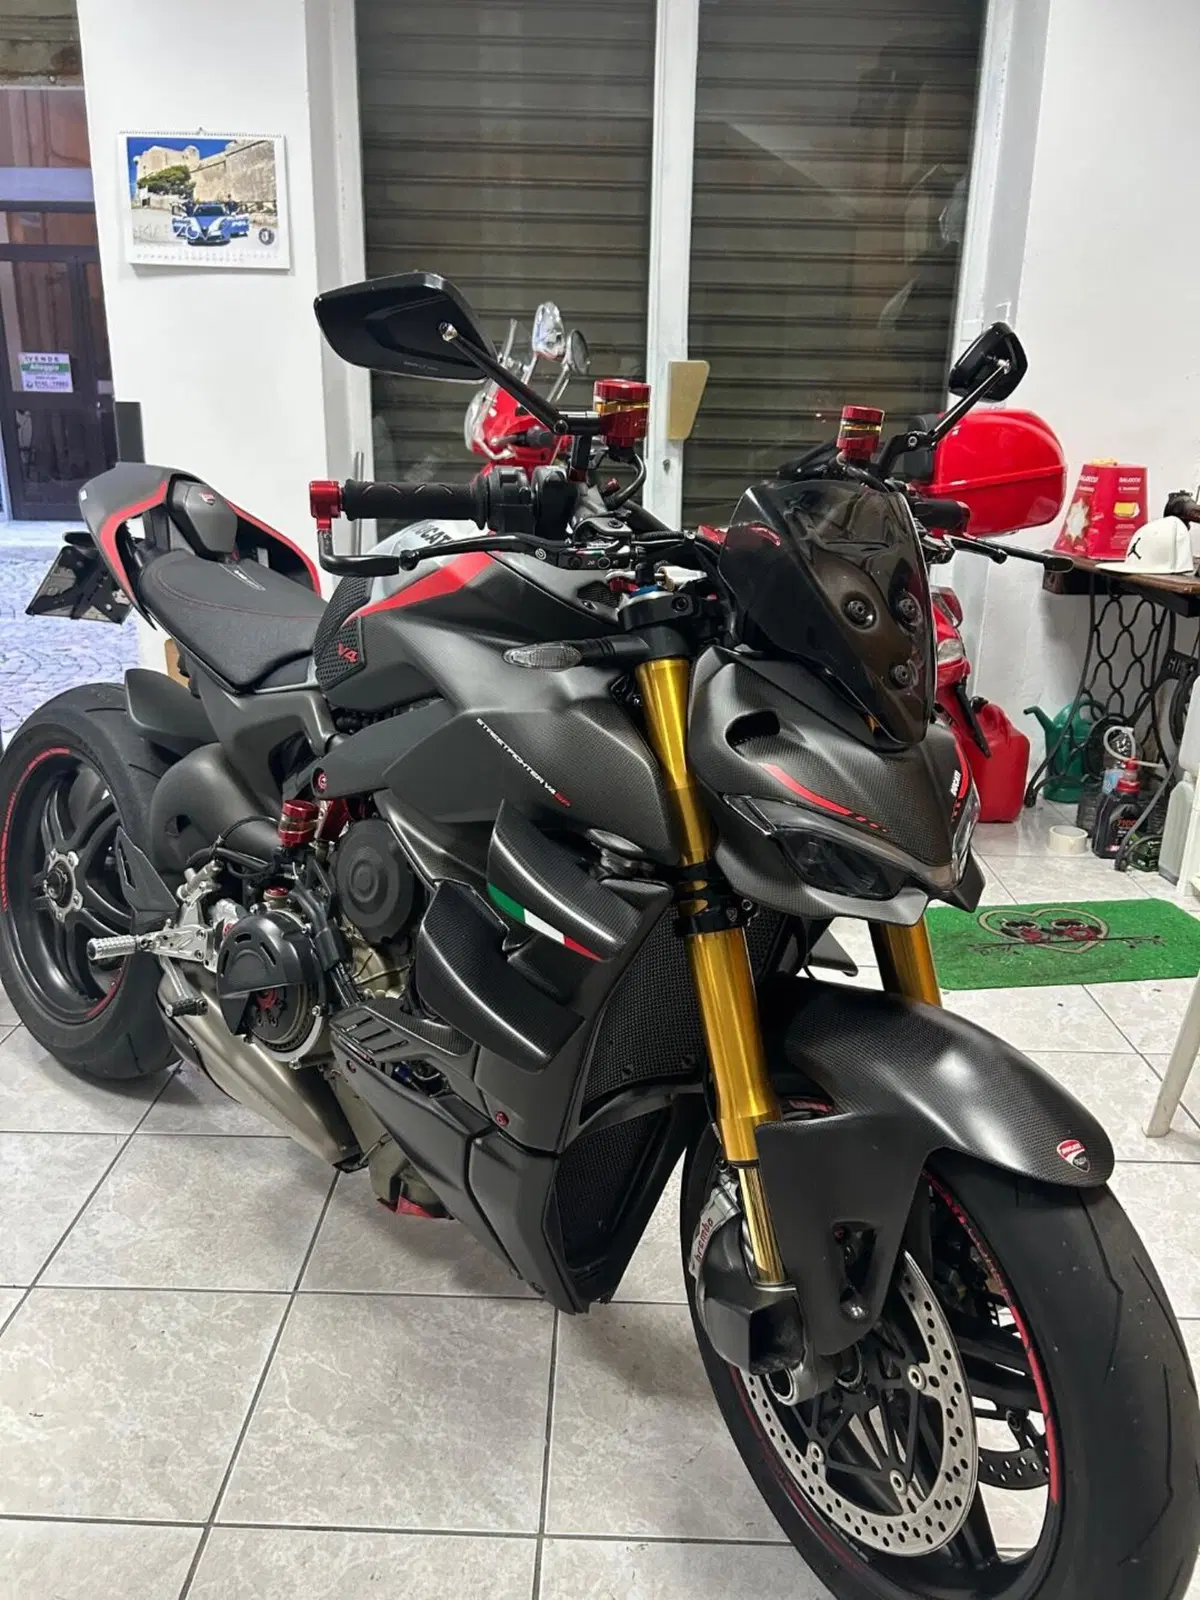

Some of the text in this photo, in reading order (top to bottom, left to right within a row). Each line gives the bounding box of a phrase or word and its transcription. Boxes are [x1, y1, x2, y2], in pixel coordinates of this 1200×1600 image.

[336, 641, 358, 663] V4
[476, 717, 545, 784] STREETFIGHTER
[544, 781, 556, 795] V4
[694, 1217, 714, 1263] brembo
